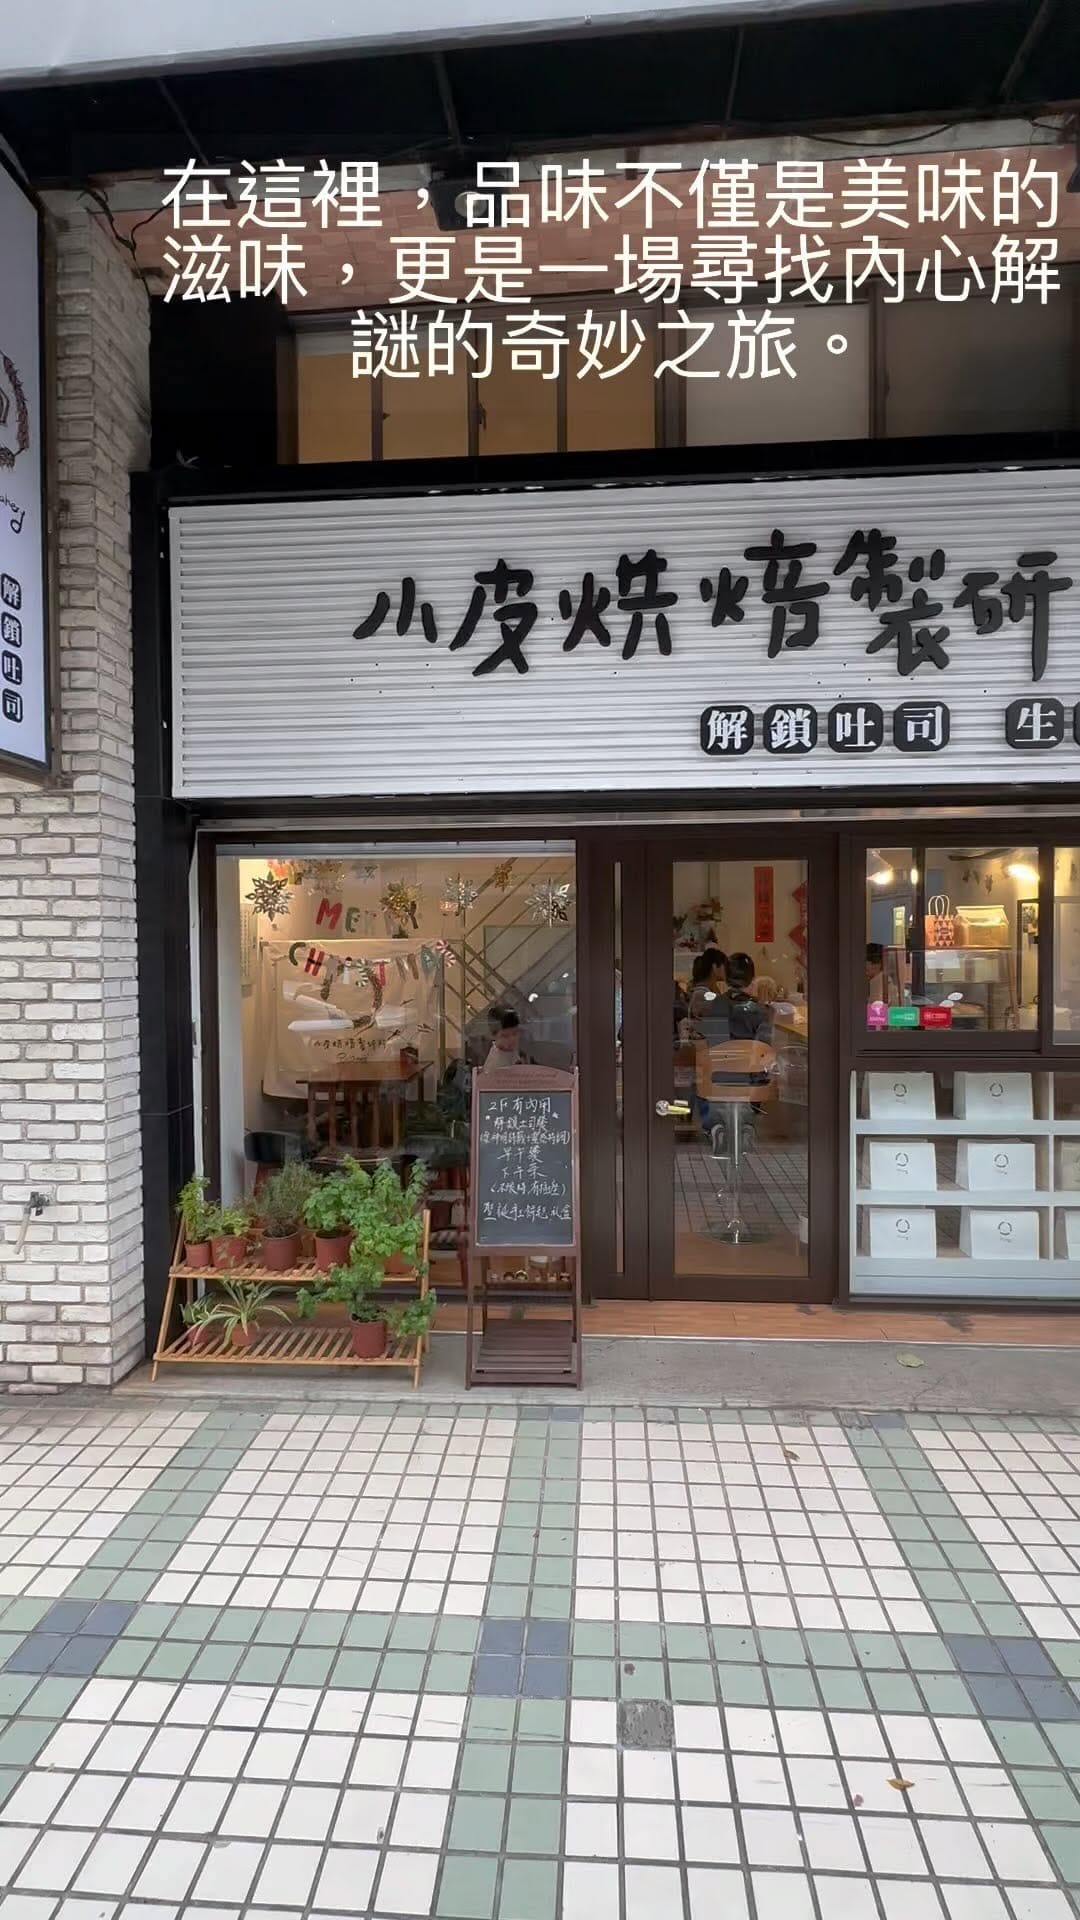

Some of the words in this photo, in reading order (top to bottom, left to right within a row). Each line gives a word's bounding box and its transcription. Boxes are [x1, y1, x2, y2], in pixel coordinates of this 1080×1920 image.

[353, 528, 1073, 682] 小皮烘焙製研
[702, 702, 948, 754] 解鎖吐司
